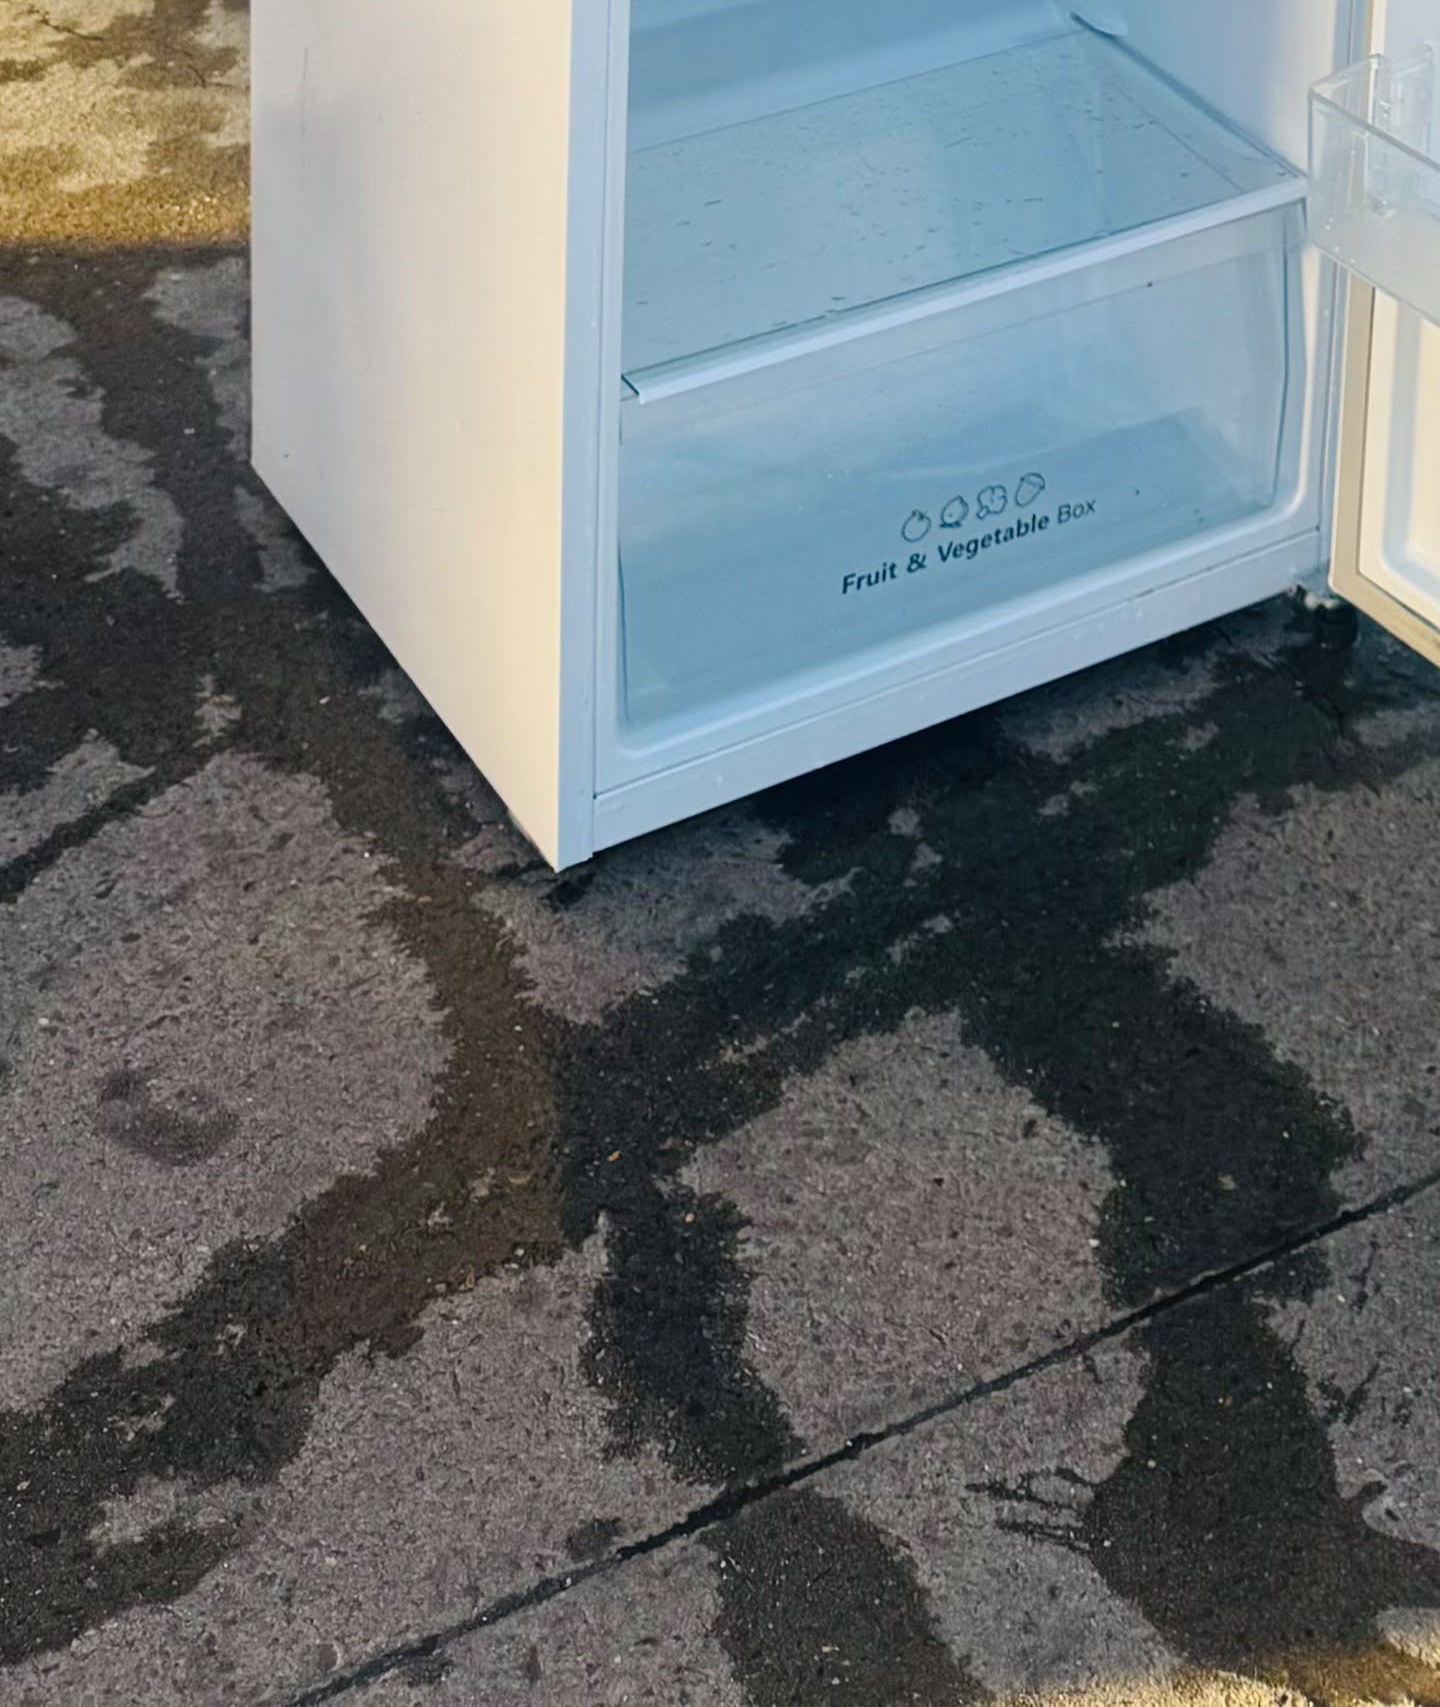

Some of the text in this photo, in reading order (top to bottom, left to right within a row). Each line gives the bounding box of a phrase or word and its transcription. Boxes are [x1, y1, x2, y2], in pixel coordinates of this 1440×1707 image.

[842, 499, 1097, 594] Fruit & Vegetable Box
